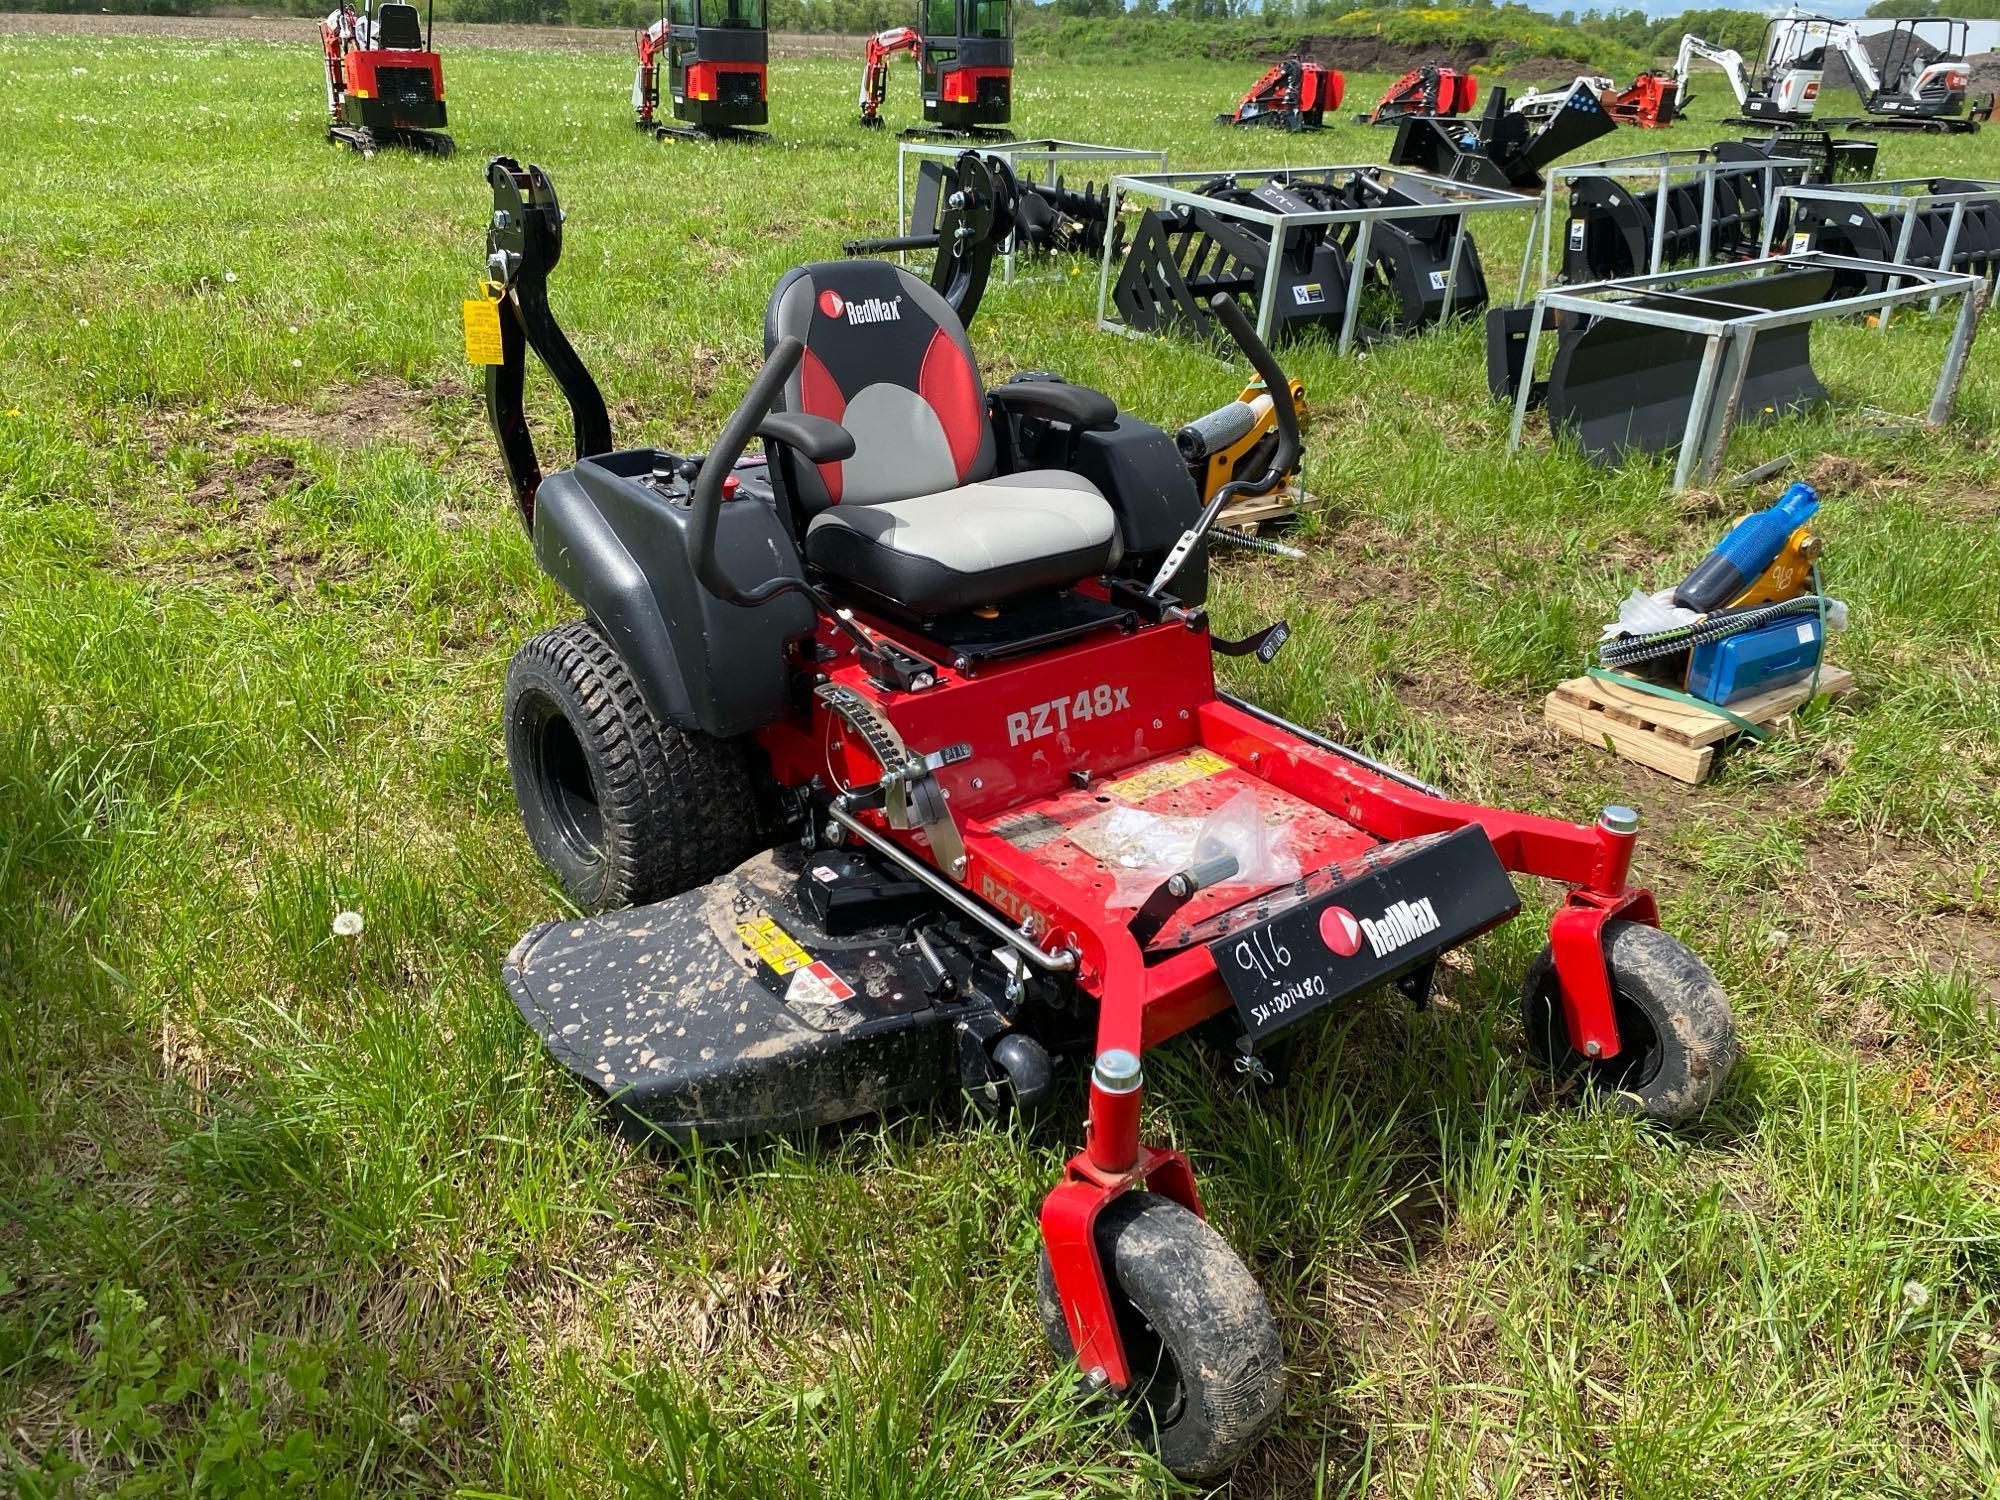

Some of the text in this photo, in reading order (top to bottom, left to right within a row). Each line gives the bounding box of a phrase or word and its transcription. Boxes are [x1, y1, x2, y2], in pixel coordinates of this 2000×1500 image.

[1006, 684, 1131, 747] RZT48x
[982, 874, 1051, 935] RZT48
[1359, 896, 1441, 959] RedMax
[1235, 924, 1291, 979] 916
